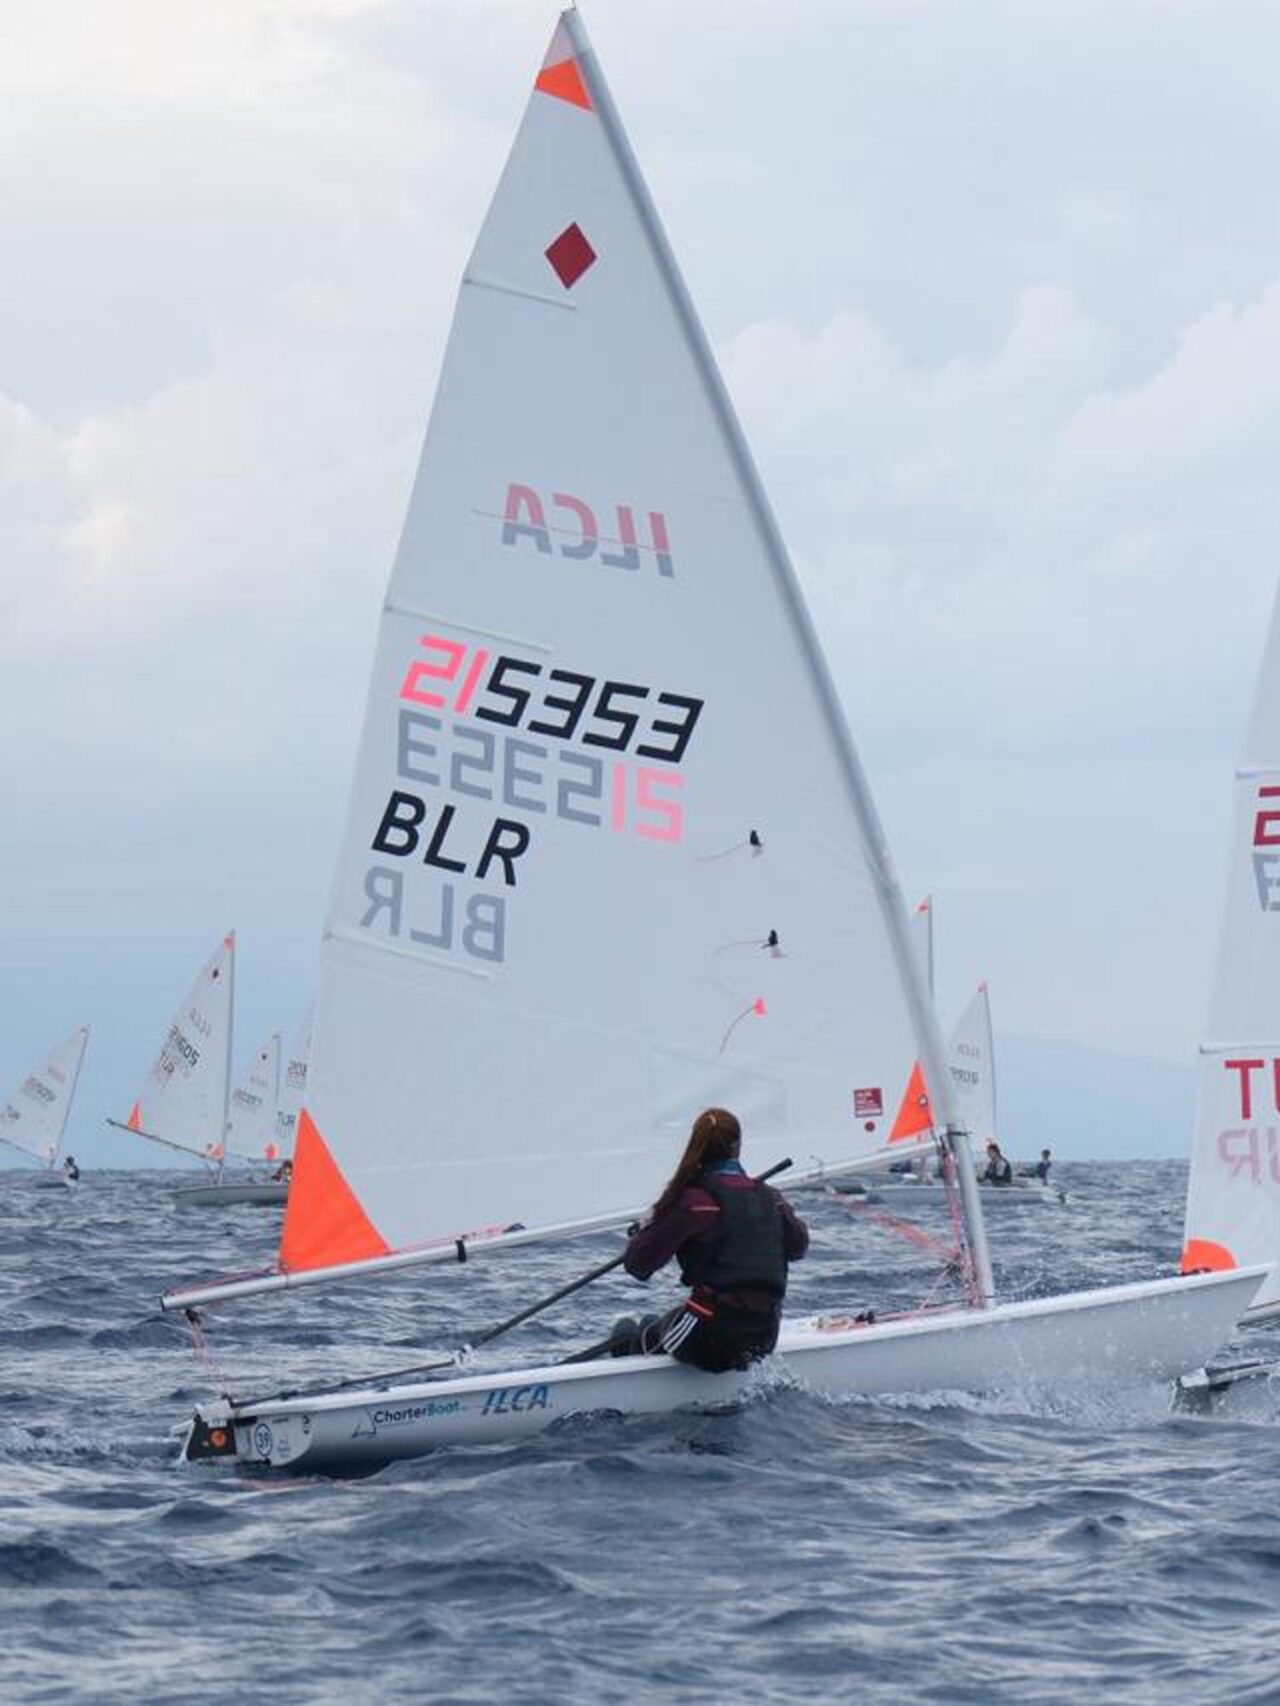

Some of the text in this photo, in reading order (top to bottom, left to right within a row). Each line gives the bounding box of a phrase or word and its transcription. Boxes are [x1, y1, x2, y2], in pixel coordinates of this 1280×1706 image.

[398, 633, 705, 764] 215353
[371, 789, 531, 887] BLR
[479, 1385, 551, 1417] ILCA
